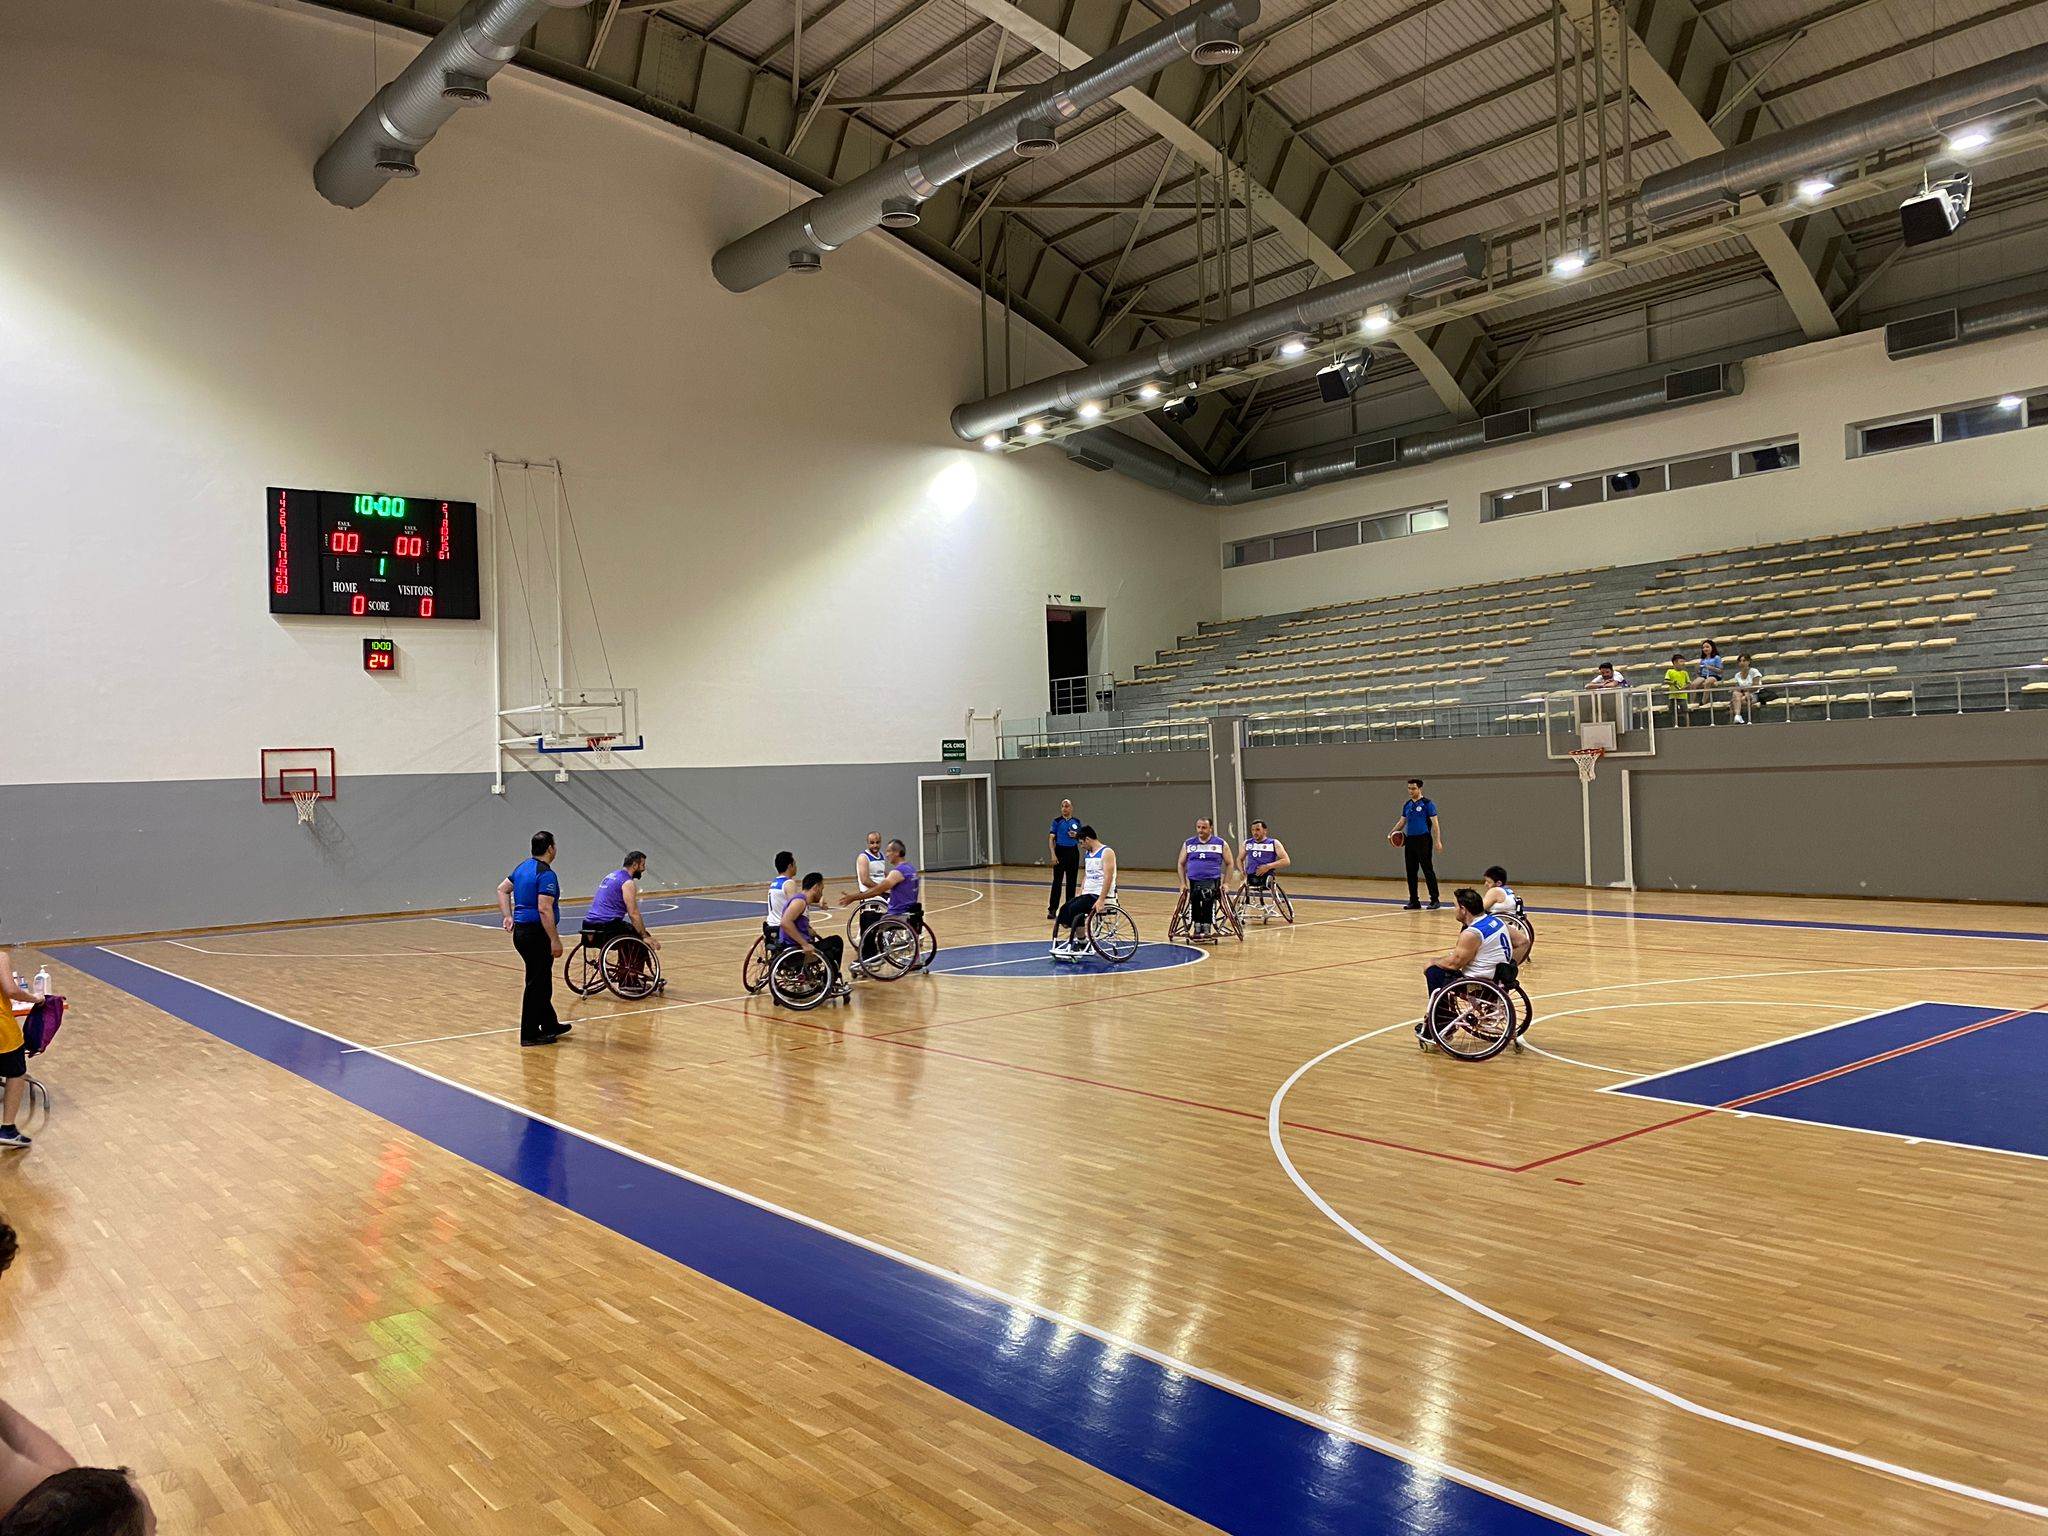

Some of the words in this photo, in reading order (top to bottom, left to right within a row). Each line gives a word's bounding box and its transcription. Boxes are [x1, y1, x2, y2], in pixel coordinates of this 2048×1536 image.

[354, 495, 405, 518] 10:00
[333, 532, 359, 553] 00
[396, 536, 422, 557] 00
[379, 558, 385, 576] 1
[332, 581, 358, 593] HOME
[398, 584, 434, 596] VISITORS
[352, 595, 365, 615] 0
[368, 600, 390, 611] SCORE
[420, 598, 432, 617] 0
[369, 654, 389, 668] 24
